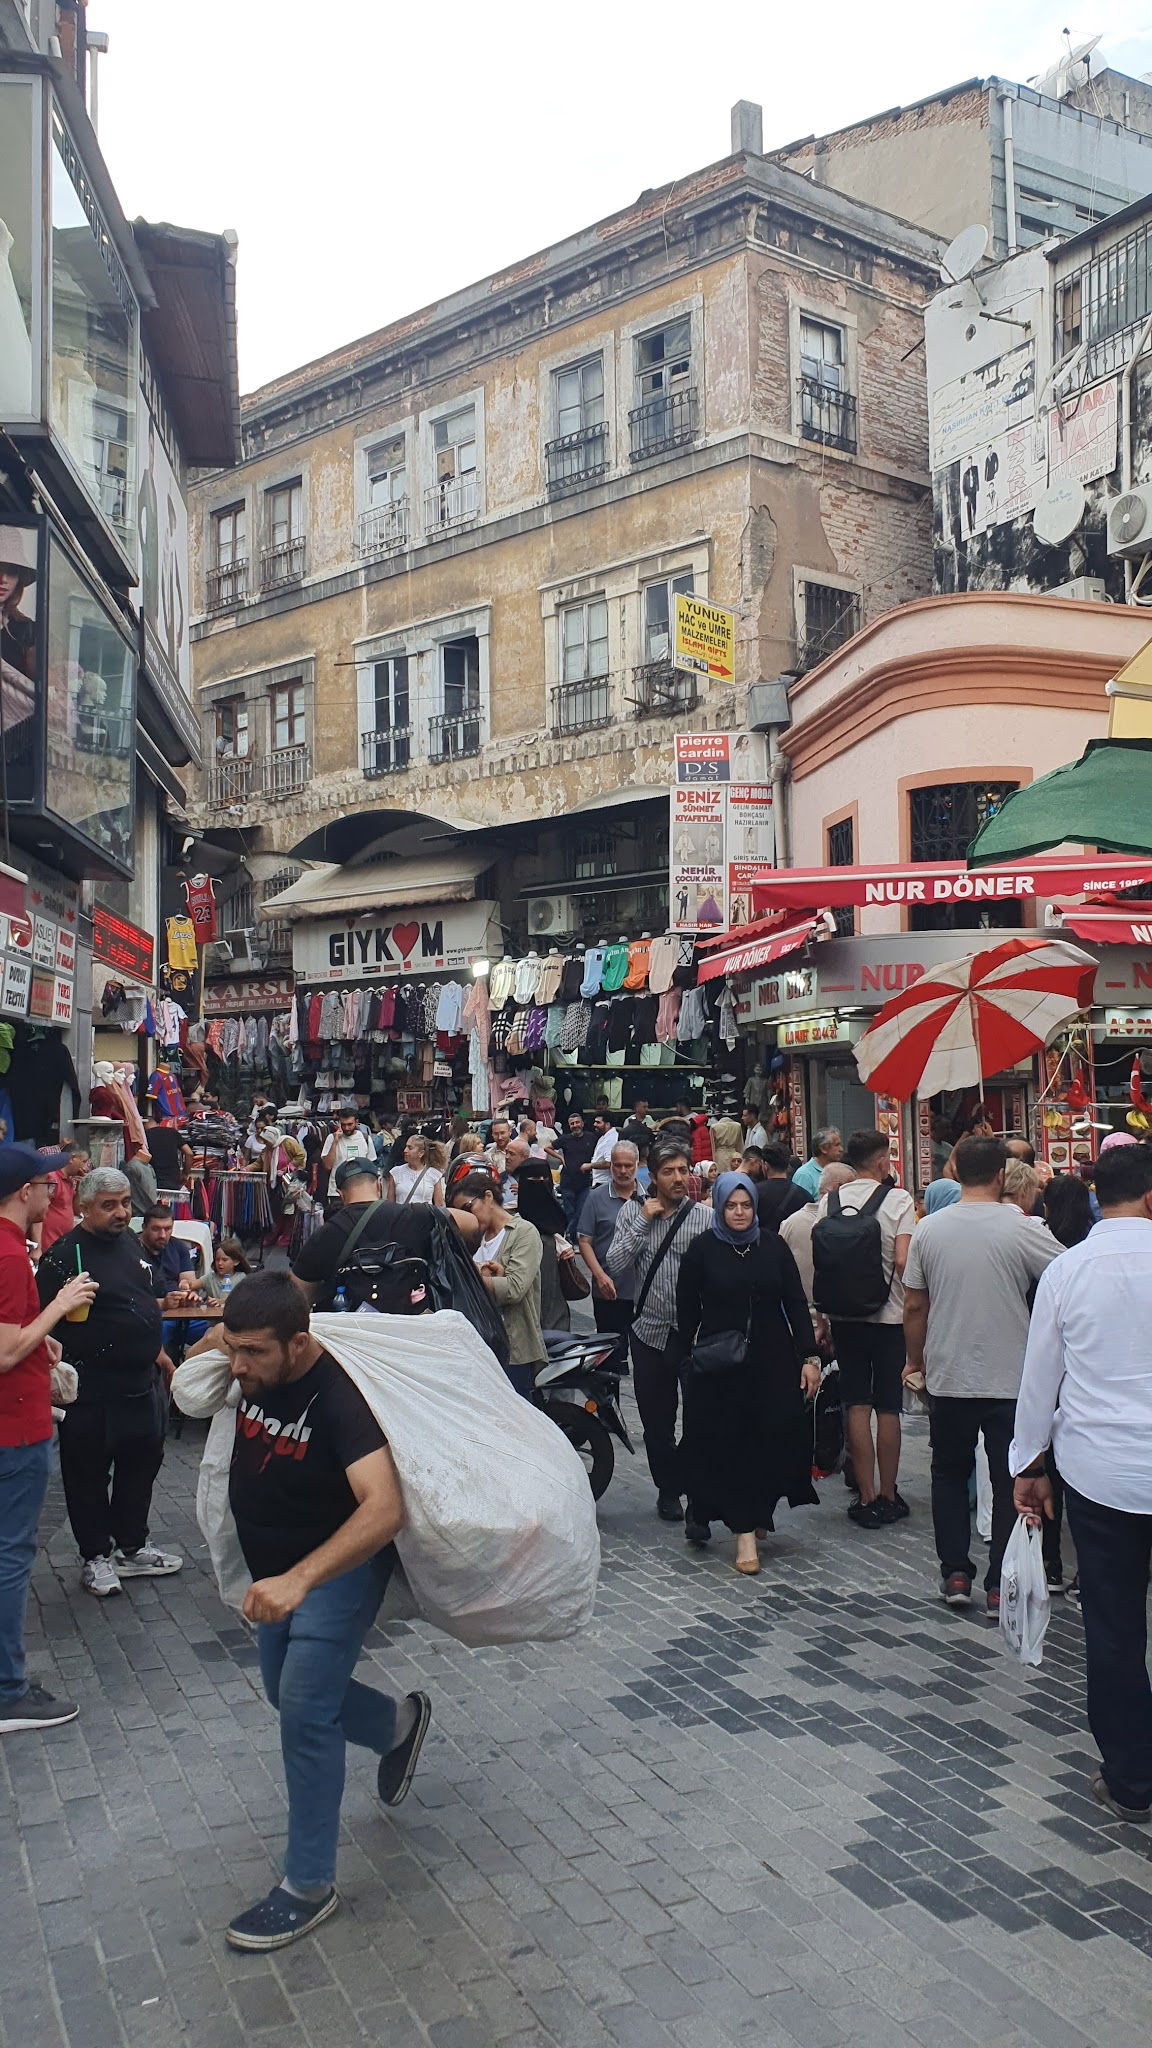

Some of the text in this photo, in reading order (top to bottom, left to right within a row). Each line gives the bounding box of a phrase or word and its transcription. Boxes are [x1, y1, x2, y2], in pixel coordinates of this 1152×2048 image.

[1051, 401, 1115, 466] HACI
[686, 601, 727, 624] YUNUS
[679, 611, 731, 640] HAC ve UMRE
[681, 626, 728, 650] MALZEMELERİ
[679, 736, 723, 747] pierre
[679, 748, 725, 759] cardin
[676, 788, 721, 804] DENİZ
[730, 786, 772, 801] GENÇ MODA
[682, 804, 715, 813] SÜNNET
[675, 814, 723, 823] KIYAFETLERİ
[681, 865, 717, 875] NEHİR
[675, 875, 701, 884] ÇOCUK
[866, 875, 1035, 902] NUR DÖNER
[723, 954, 743, 973] NUR
[741, 945, 771, 968] DÖNER
